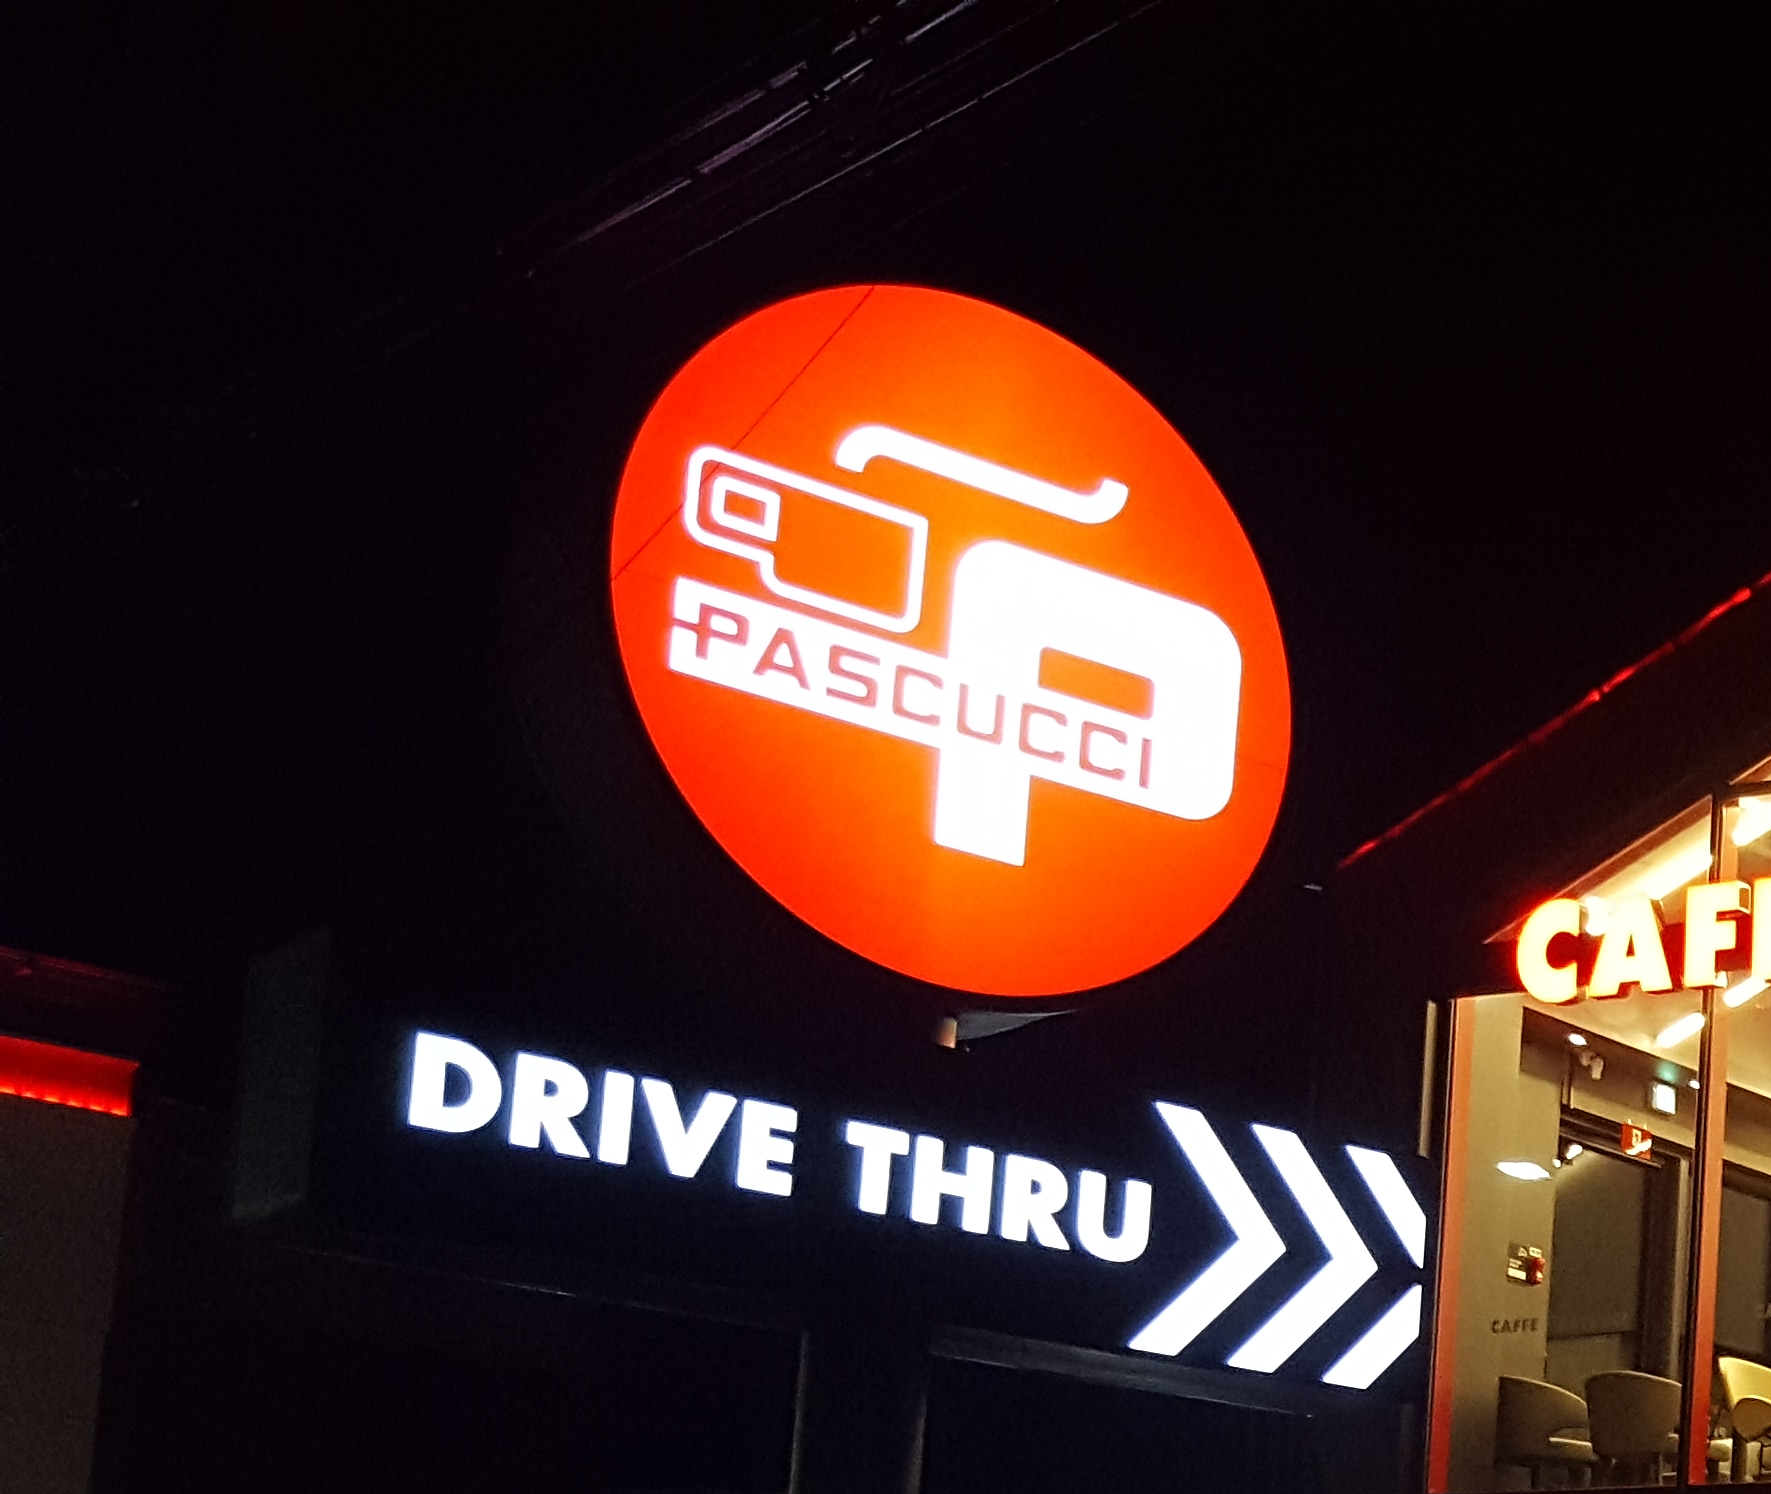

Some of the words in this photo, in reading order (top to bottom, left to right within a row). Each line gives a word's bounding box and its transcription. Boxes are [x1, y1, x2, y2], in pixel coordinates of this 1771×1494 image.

[688, 602, 1153, 791] PASCUCCI
[407, 1031, 799, 1198] DRIVE
[845, 1118, 1153, 1264] THRU
